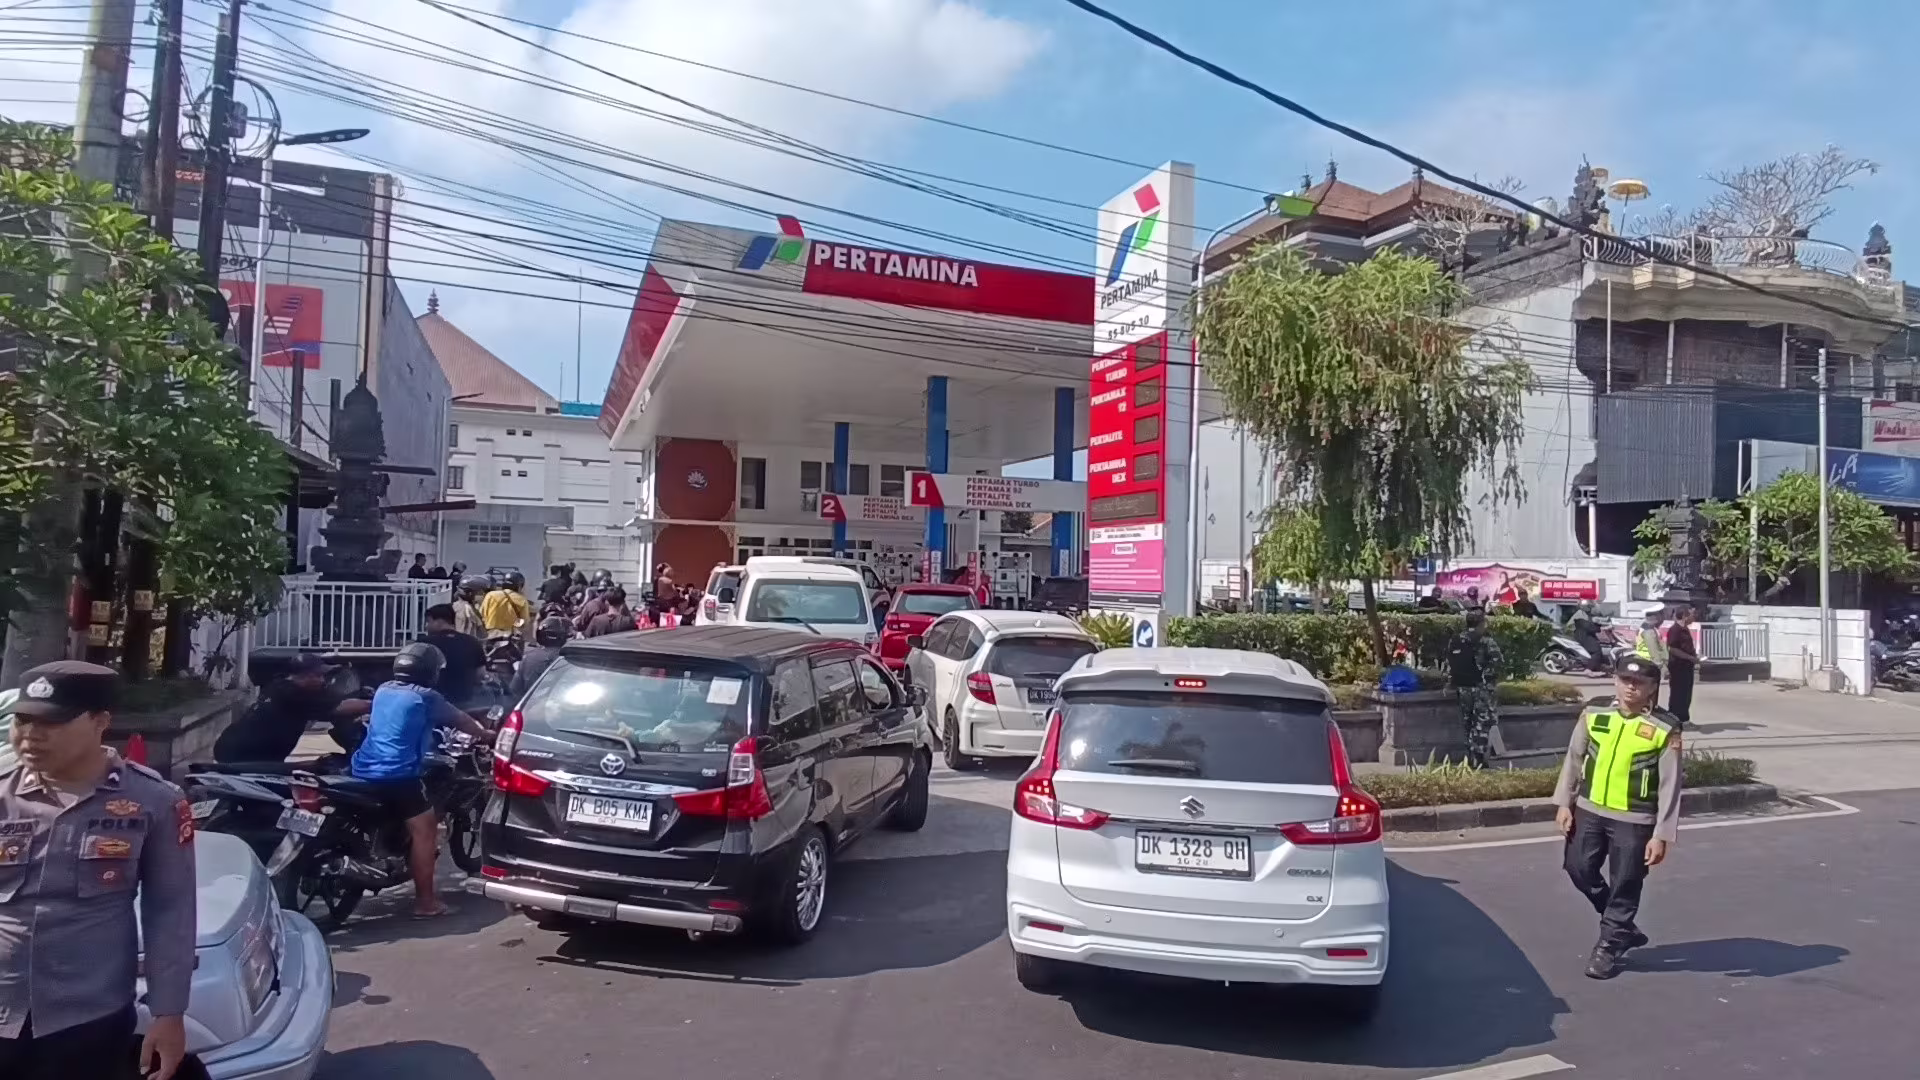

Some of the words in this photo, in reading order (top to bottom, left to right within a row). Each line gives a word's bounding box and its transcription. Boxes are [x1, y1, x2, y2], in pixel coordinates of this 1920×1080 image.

[814, 243, 979, 287] PERTAMINA
[1100, 268, 1160, 310] PERTAMINA
[1090, 386, 1127, 407] PERTAMAX
[1089, 430, 1123, 447] PERTALITE
[1089, 457, 1127, 474] PERTAMINA
[966, 477, 1012, 486] PERTAMAX
[1013, 480, 1040, 488] TURBO
[1111, 472, 1127, 484] DEX
[916, 479, 927, 499] 1
[966, 484, 1011, 493] PERTAMAX
[966, 491, 1011, 501] PERTALITE
[823, 499, 836, 513] 2
[966, 499, 1014, 508] PERTAMINA
[1015, 501, 1032, 509] DEX
[570, 796, 587, 814] DK
[624, 802, 648, 820] KMA
[1141, 835, 1162, 856] DK
[1169, 836, 1213, 858] 1328
[1223, 840, 1246, 861] QH
